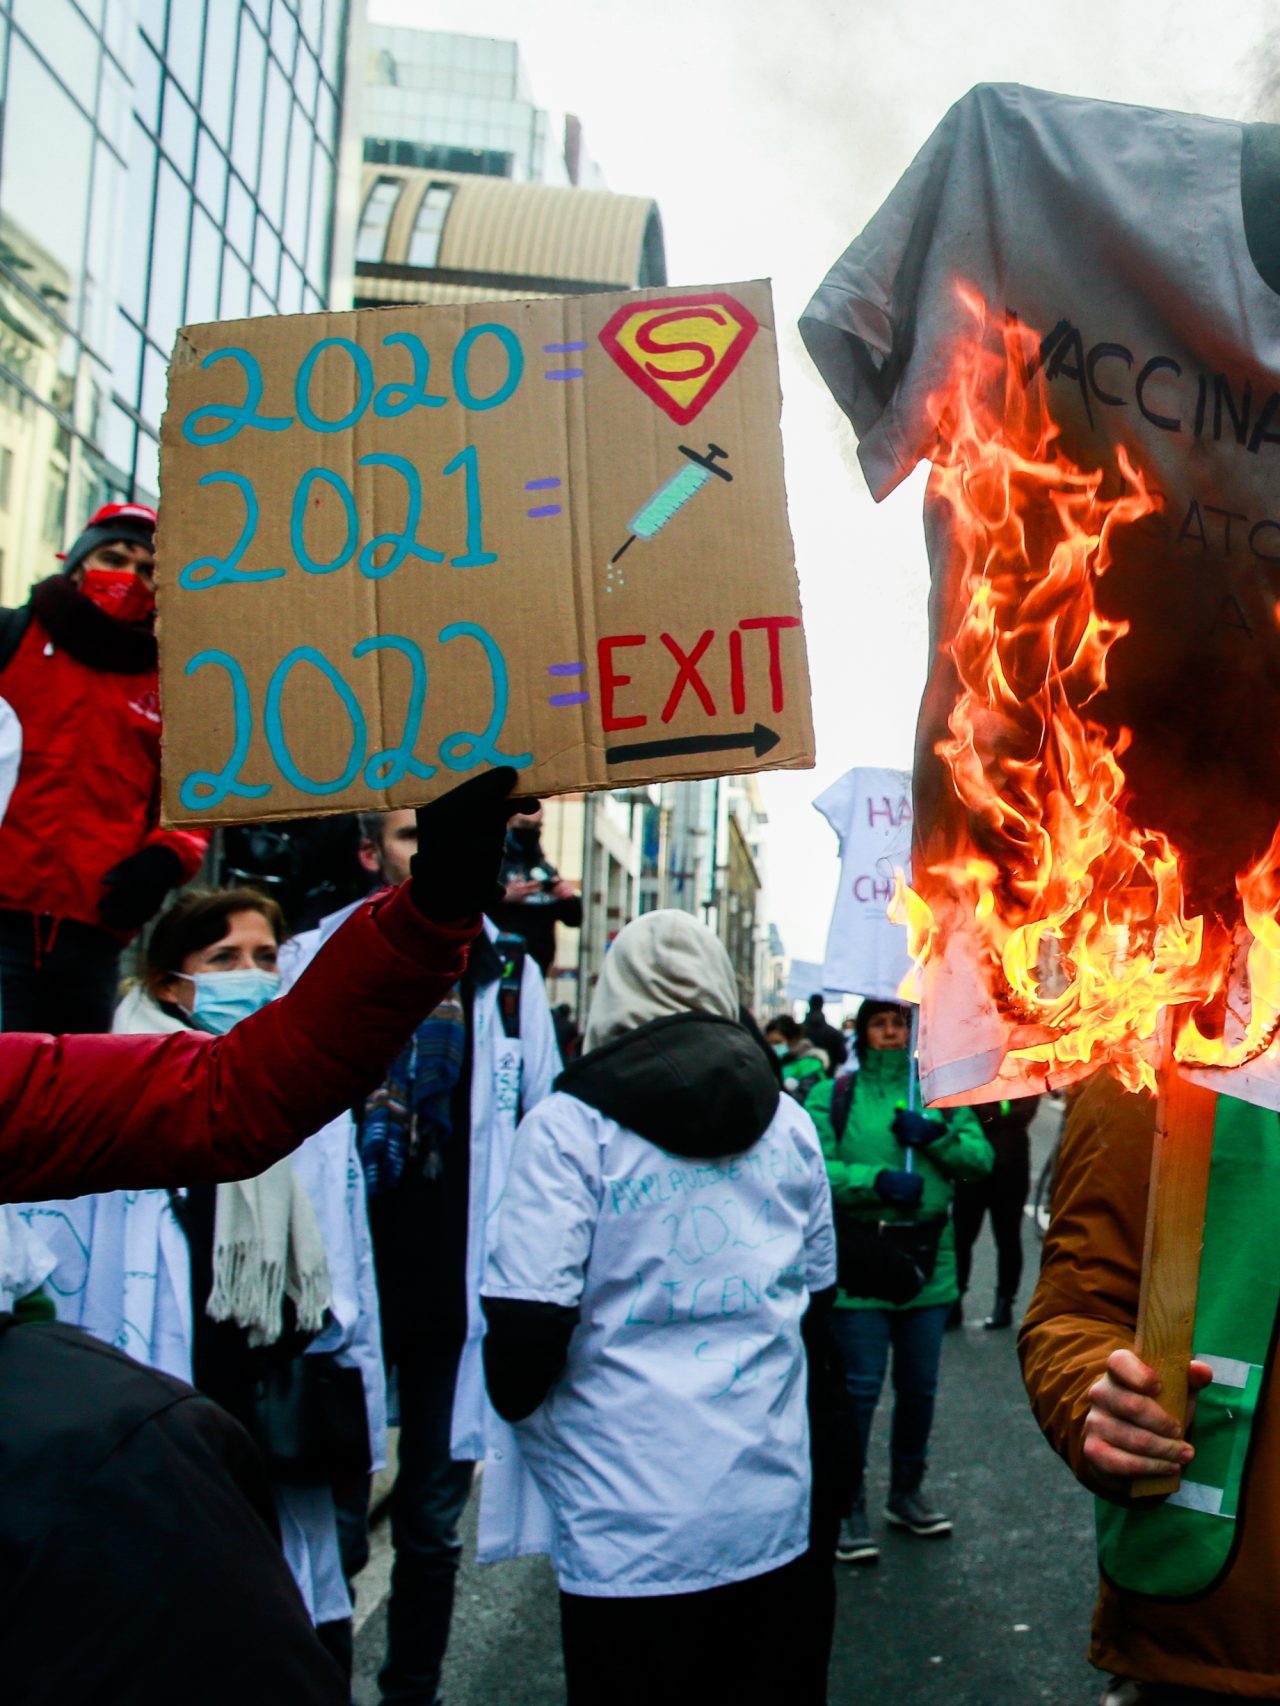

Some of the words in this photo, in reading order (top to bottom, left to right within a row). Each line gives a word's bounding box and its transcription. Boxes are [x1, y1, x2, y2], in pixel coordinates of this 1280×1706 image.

[182, 322, 525, 446] 2020
[179, 444, 499, 591] 2021
[180, 621, 534, 811] 2022
[598, 615, 800, 732] EXIT
